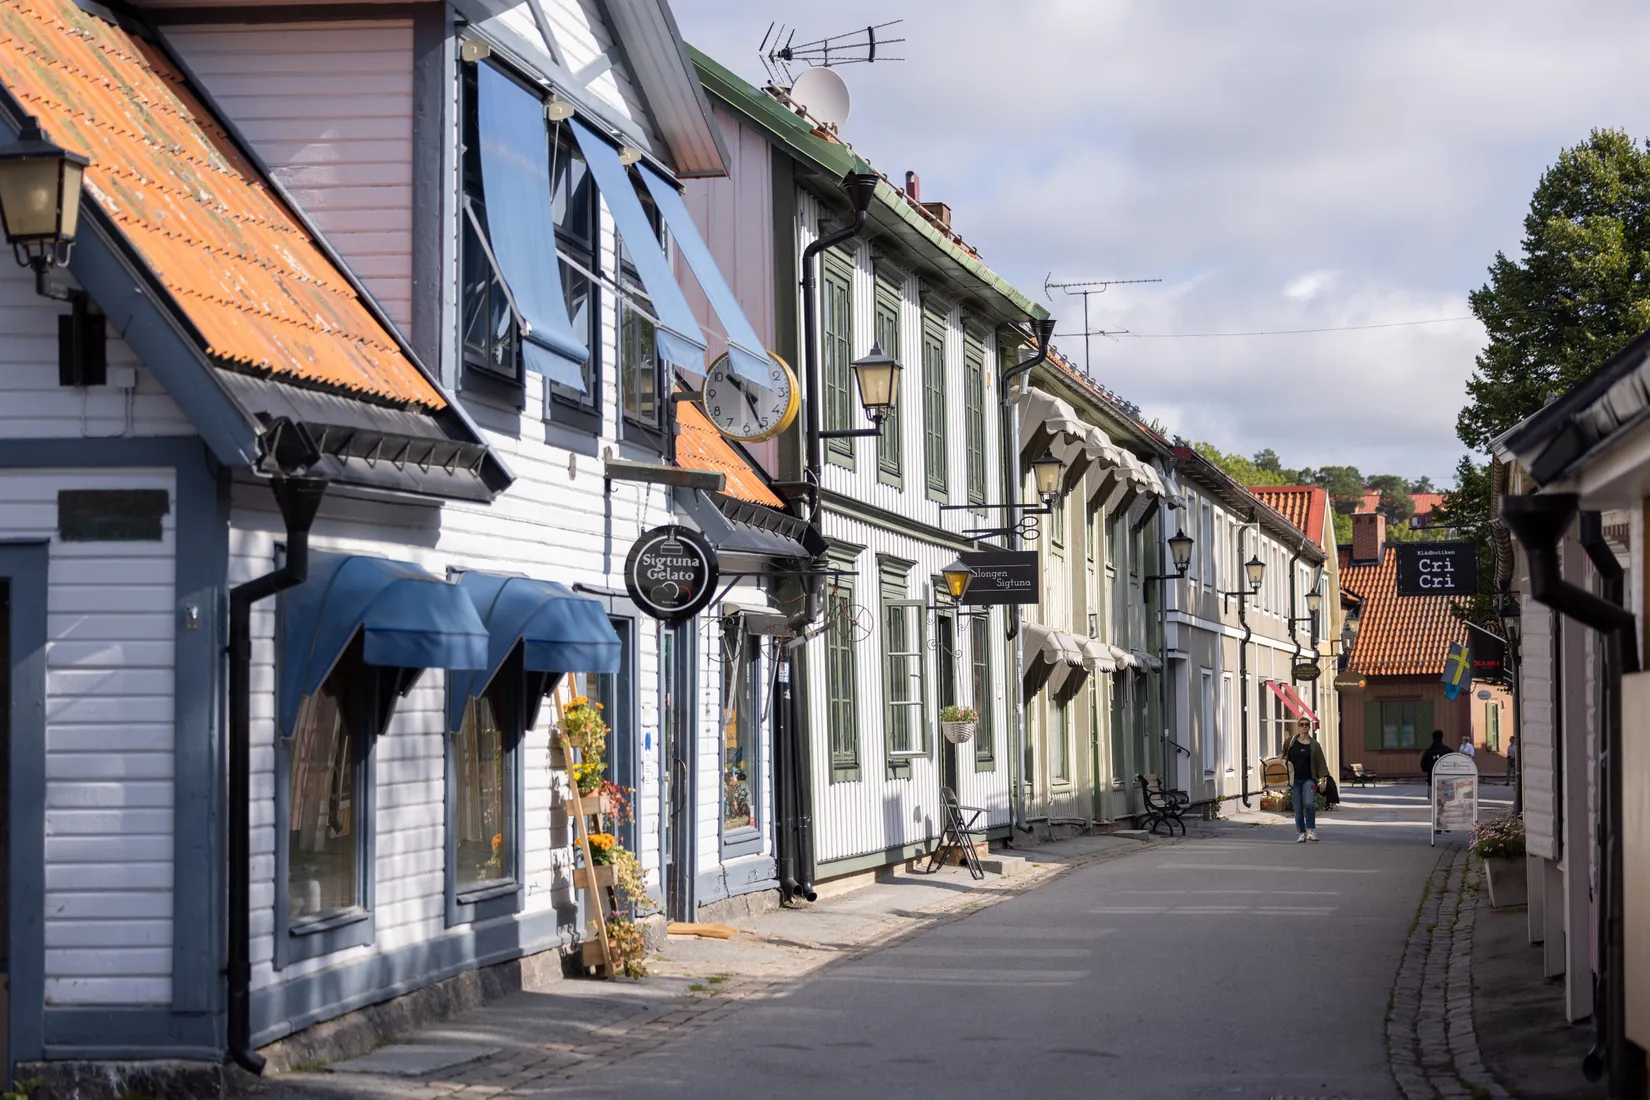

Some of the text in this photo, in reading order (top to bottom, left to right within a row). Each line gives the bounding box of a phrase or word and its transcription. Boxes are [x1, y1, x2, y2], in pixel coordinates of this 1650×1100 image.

[714, 371, 724, 382] 10
[772, 371, 781, 381] 2
[708, 391, 717, 400] 9
[778, 387, 785, 398] 3
[713, 405, 721, 417] 8
[771, 404, 780, 415] 4
[726, 417, 734, 428] 7
[742, 422, 751, 433] 6
[761, 416, 769, 428] 5
[642, 553, 700, 572] Sigtuna
[1418, 557, 1455, 573] Cri
[646, 567, 695, 581] Gelato
[971, 568, 1008, 580] alongen
[996, 578, 1031, 589] Sigtuna
[1419, 573, 1455, 588] Cri
